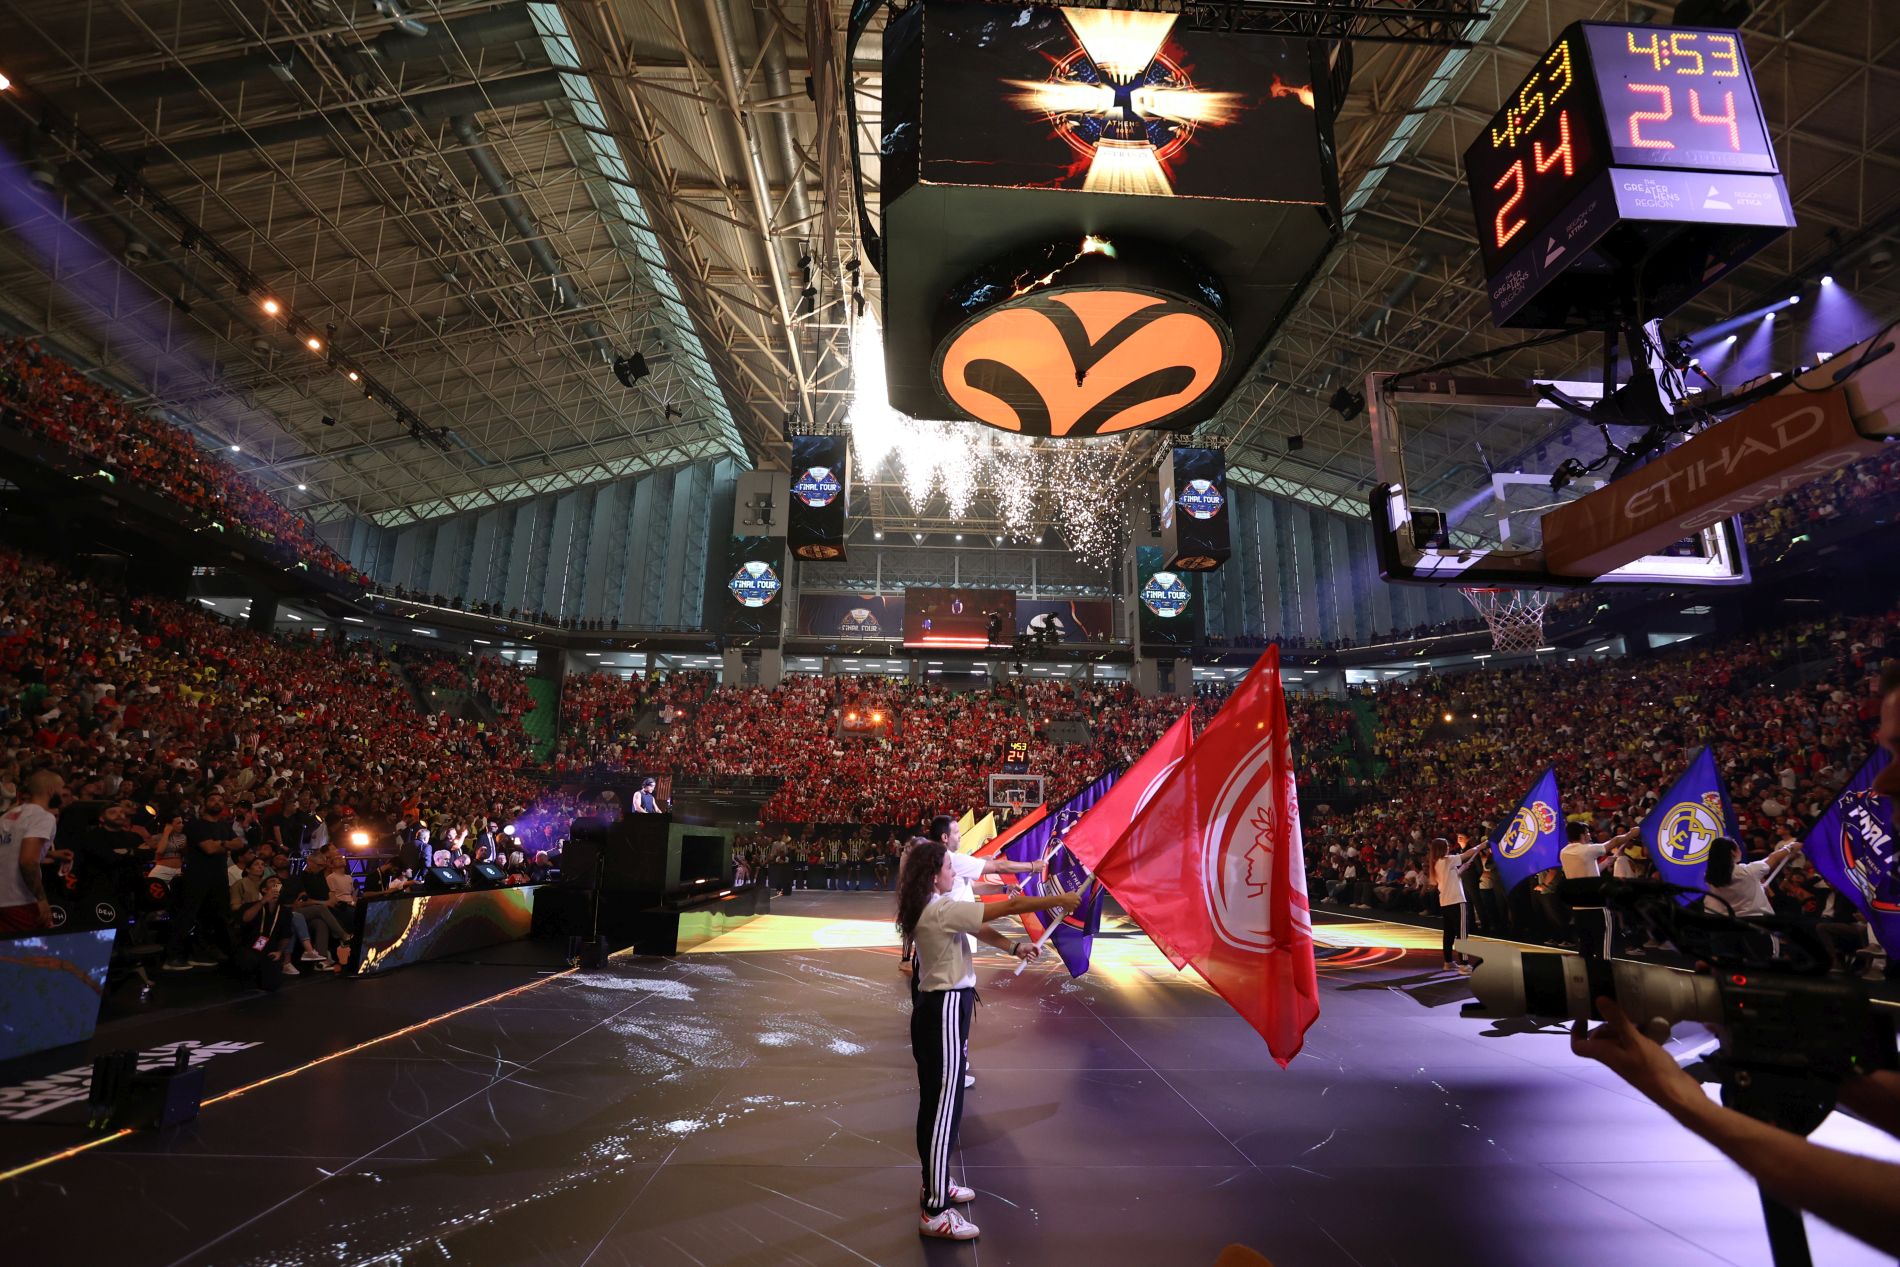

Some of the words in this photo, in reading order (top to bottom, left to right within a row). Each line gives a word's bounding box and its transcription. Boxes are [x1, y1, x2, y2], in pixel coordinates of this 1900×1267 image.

[1627, 32, 1739, 77] 4:53
[1492, 40, 1572, 147] 4:53
[1627, 83, 1741, 151] 24
[1494, 109, 1574, 248] 24
[1635, 199, 1673, 208] REGION
[1568, 219, 1588, 239] ATTICA
[1624, 405, 1825, 519] ETIHAD
[799, 483, 818, 491] FINAL
[820, 483, 837, 491] FOUR
[1680, 451, 1861, 530] ETIHAD
[734, 580, 755, 589] FINAL
[757, 580, 775, 589] FOUR
[1146, 590, 1166, 599] FINAL
[1168, 591, 1186, 600] FOUR
[1007, 751, 1025, 762] 24
